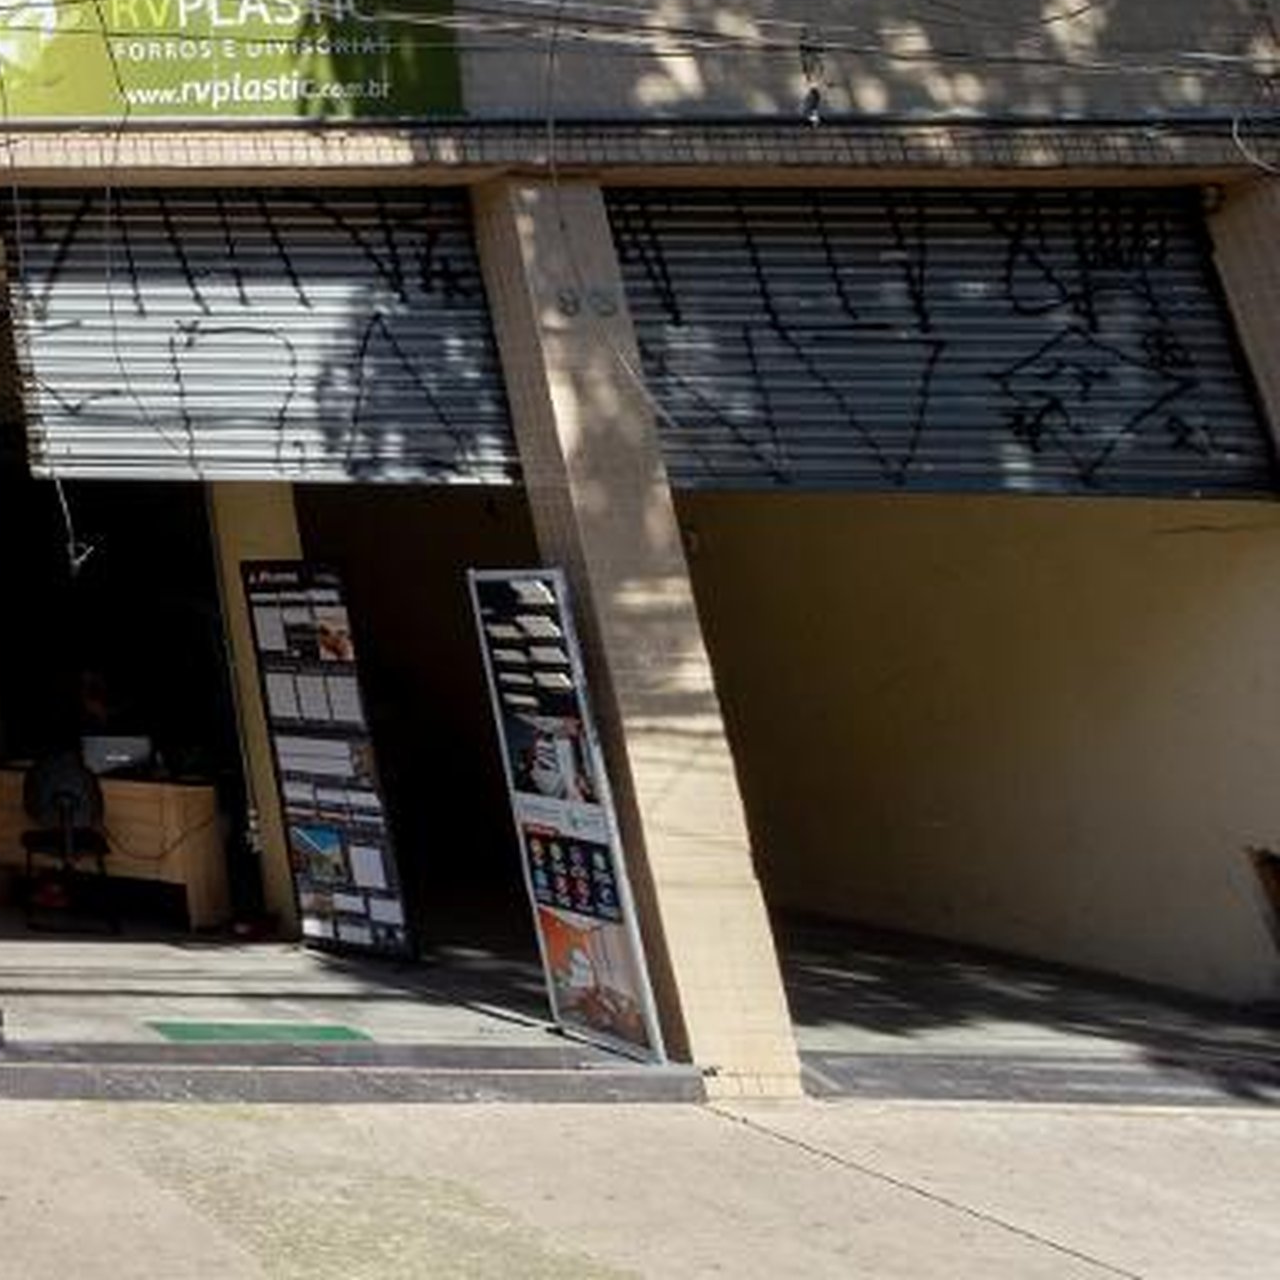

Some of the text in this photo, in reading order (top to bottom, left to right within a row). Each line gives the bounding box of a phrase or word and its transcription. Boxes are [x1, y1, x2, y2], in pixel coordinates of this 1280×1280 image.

[114, 39, 212, 62] FORROS
[223, 37, 237, 58] E
[124, 67, 390, 109] www.rvplastic.com.br
